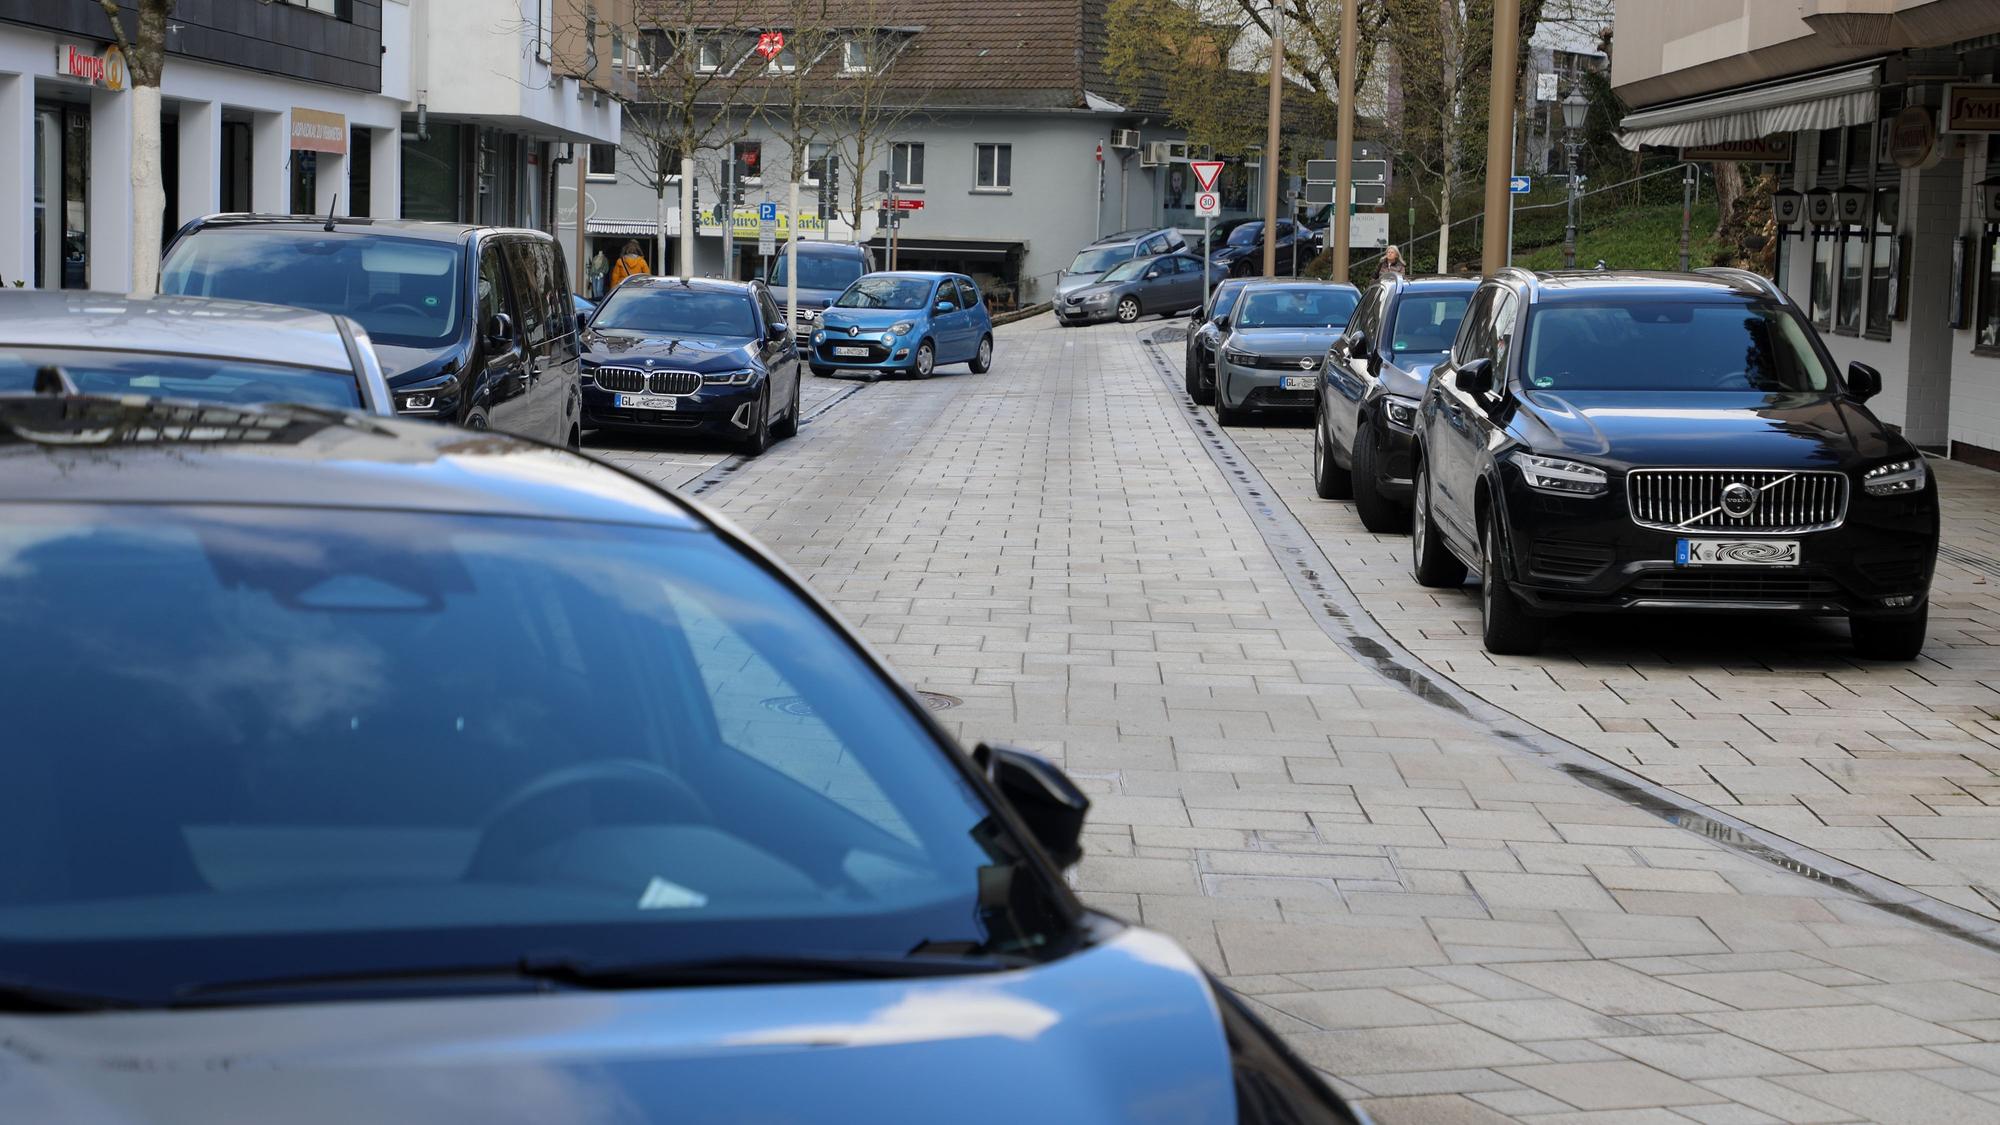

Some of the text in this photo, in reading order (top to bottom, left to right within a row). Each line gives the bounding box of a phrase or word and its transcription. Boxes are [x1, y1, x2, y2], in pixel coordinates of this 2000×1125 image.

[69, 44, 104, 87] Kamps
[1203, 198, 1212, 206] 30
[761, 205, 771, 219] P
[621, 396, 635, 407] GL
[1690, 543, 1702, 560] K
